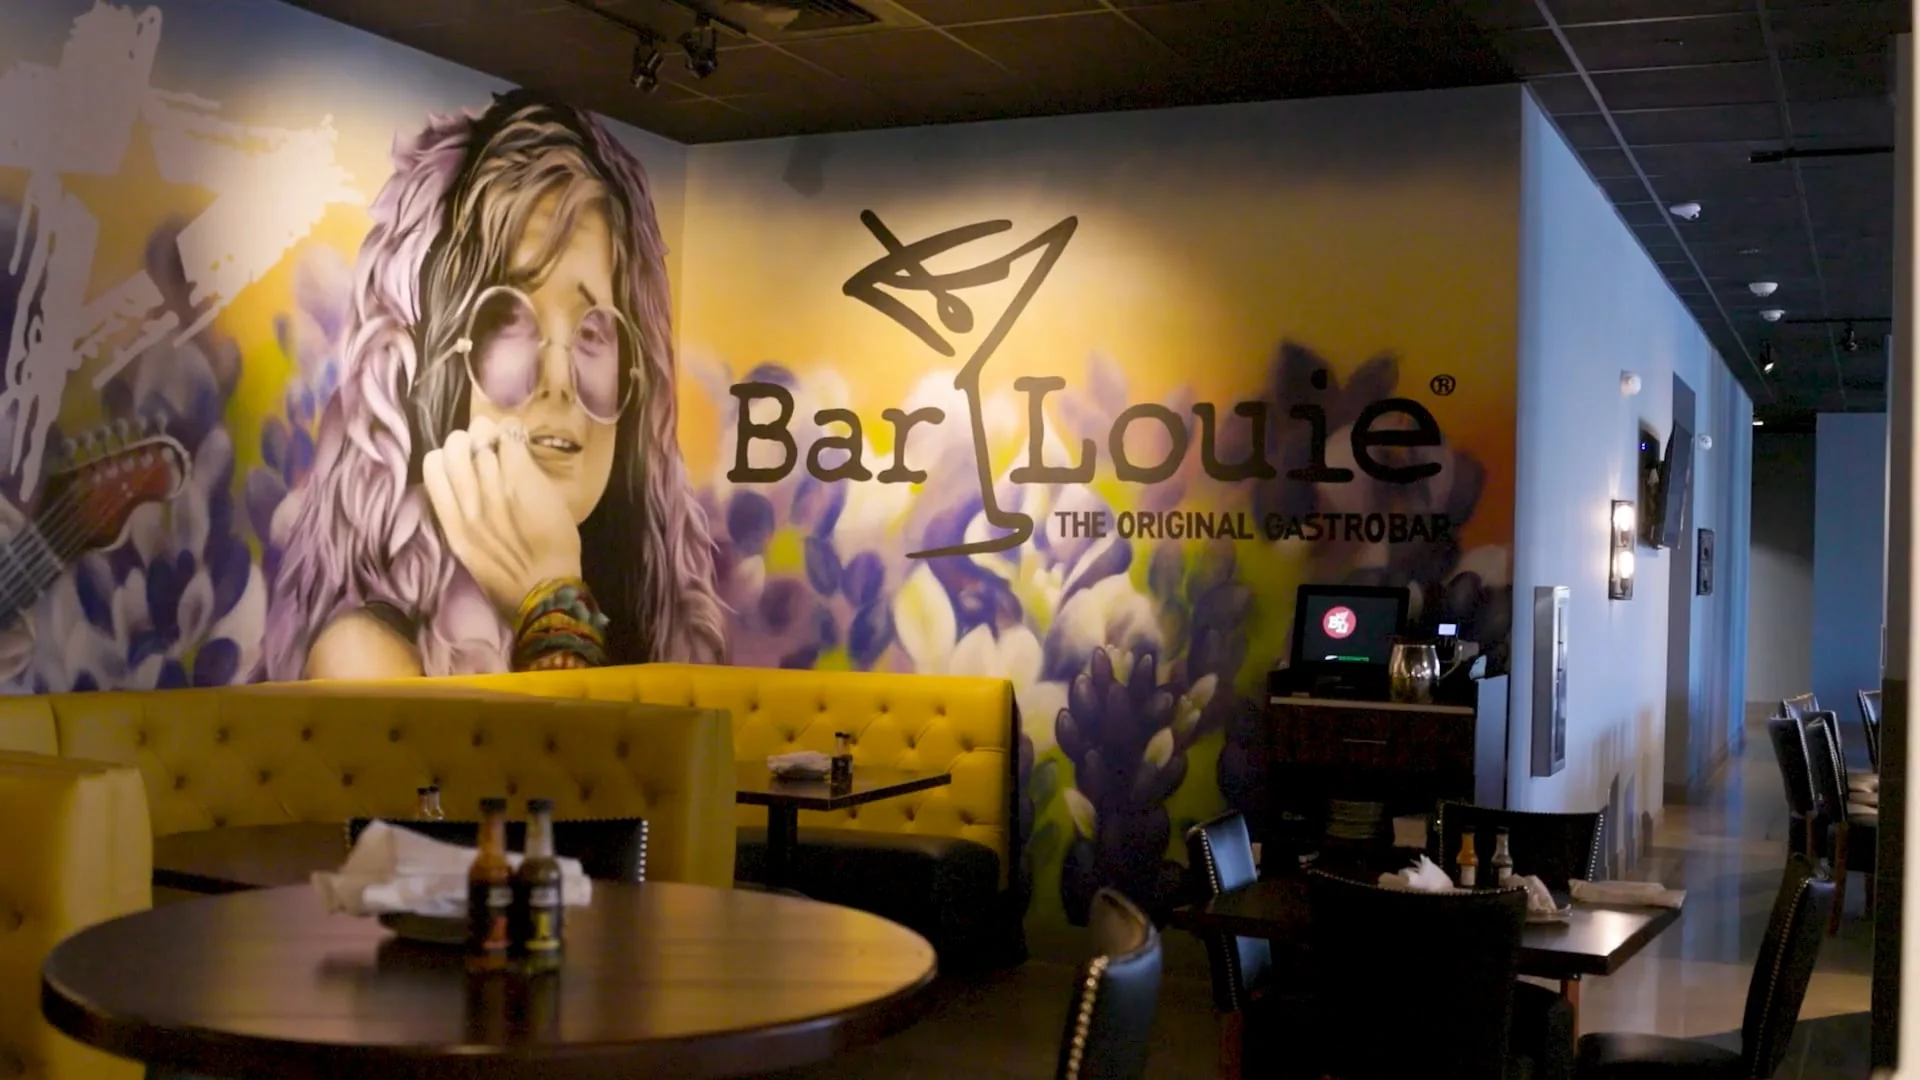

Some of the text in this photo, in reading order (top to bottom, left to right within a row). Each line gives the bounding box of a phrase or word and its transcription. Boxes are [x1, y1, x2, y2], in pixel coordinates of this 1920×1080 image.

[727, 382, 946, 484] Bar
[1009, 369, 1443, 484] Louie
[1054, 511, 1453, 544] THE ORIGINAL GASTROBAR
